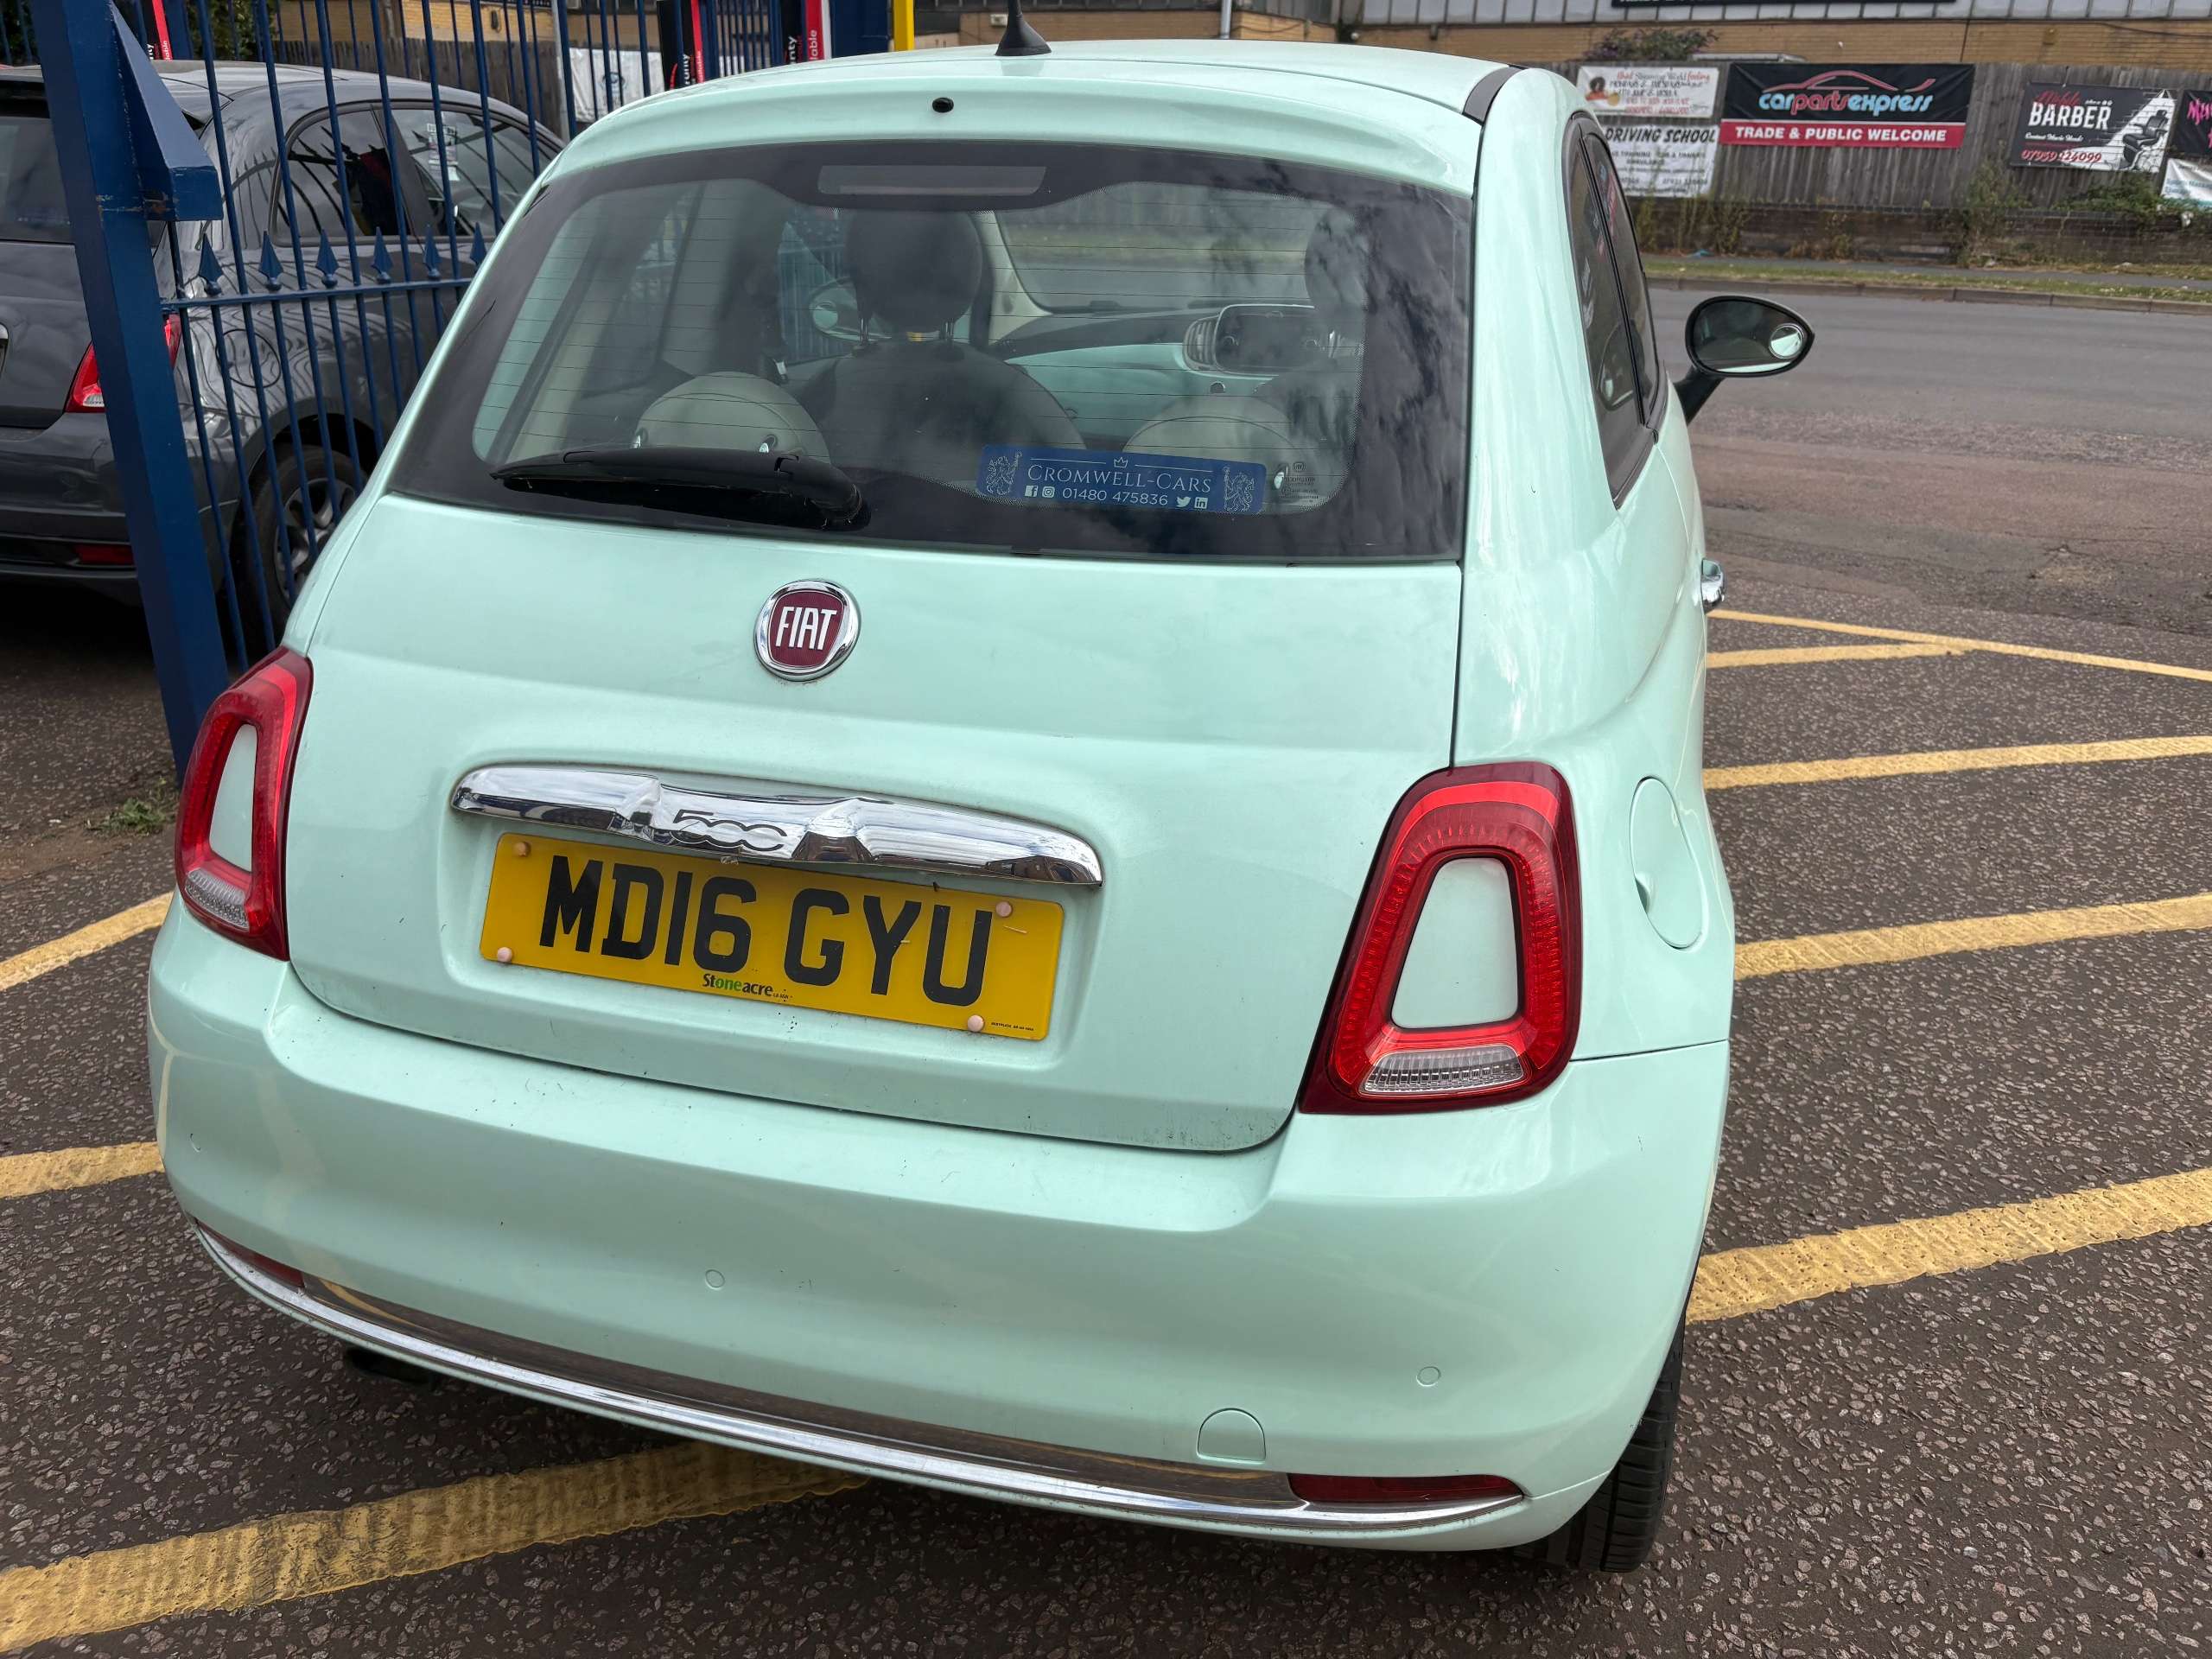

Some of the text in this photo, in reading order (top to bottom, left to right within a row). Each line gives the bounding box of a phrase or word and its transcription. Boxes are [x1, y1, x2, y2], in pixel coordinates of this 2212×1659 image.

[2028, 101, 2112, 130] BARBER
[1605, 128, 1715, 143] DRIVING SCHOOL
[1735, 126, 1947, 142] TRADE & PUBLIC WELCOME
[1062, 487, 1108, 501] 01480
[1112, 490, 1168, 506] 475836
[775, 606, 837, 651] FIAT
[670, 809, 787, 852] 500
[539, 855, 993, 1007] MD16 GYU
[702, 973, 773, 997] Stoneacre
